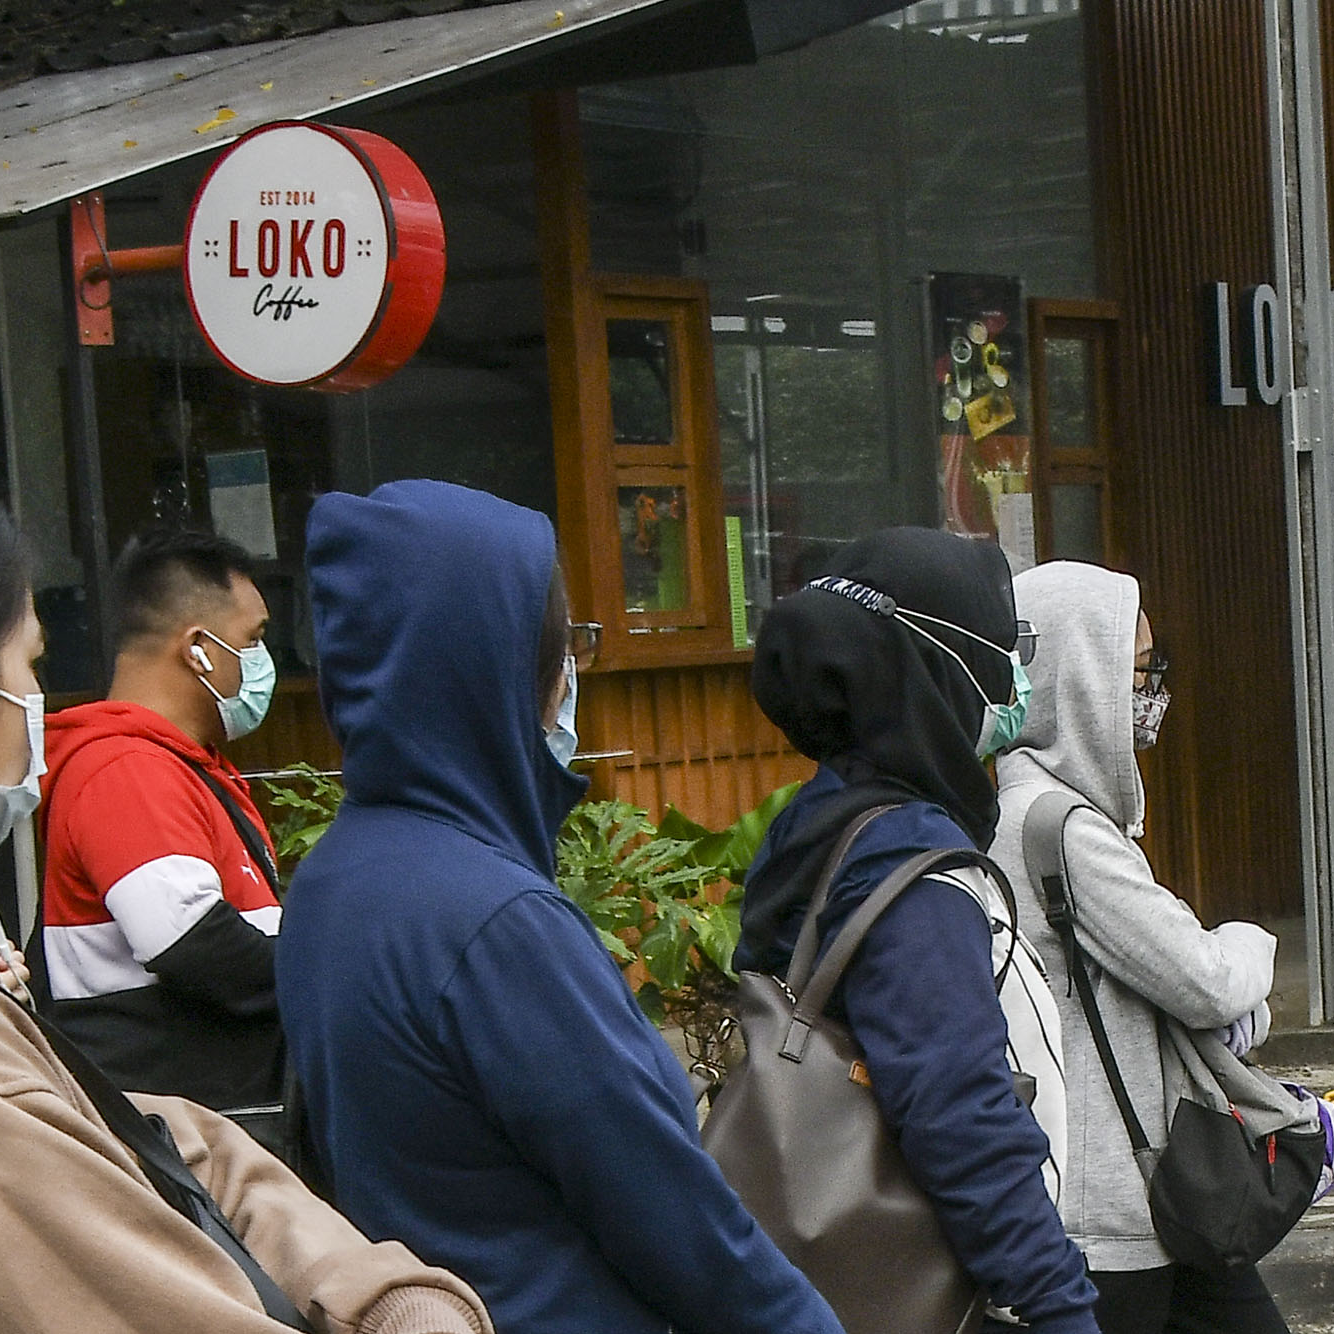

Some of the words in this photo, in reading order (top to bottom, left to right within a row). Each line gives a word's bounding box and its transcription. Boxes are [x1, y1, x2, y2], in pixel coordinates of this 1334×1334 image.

[260, 191, 280, 206] EST
[286, 191, 315, 206] 2014
[229, 219, 346, 278] LOKO
[253, 283, 319, 321] Coffee
